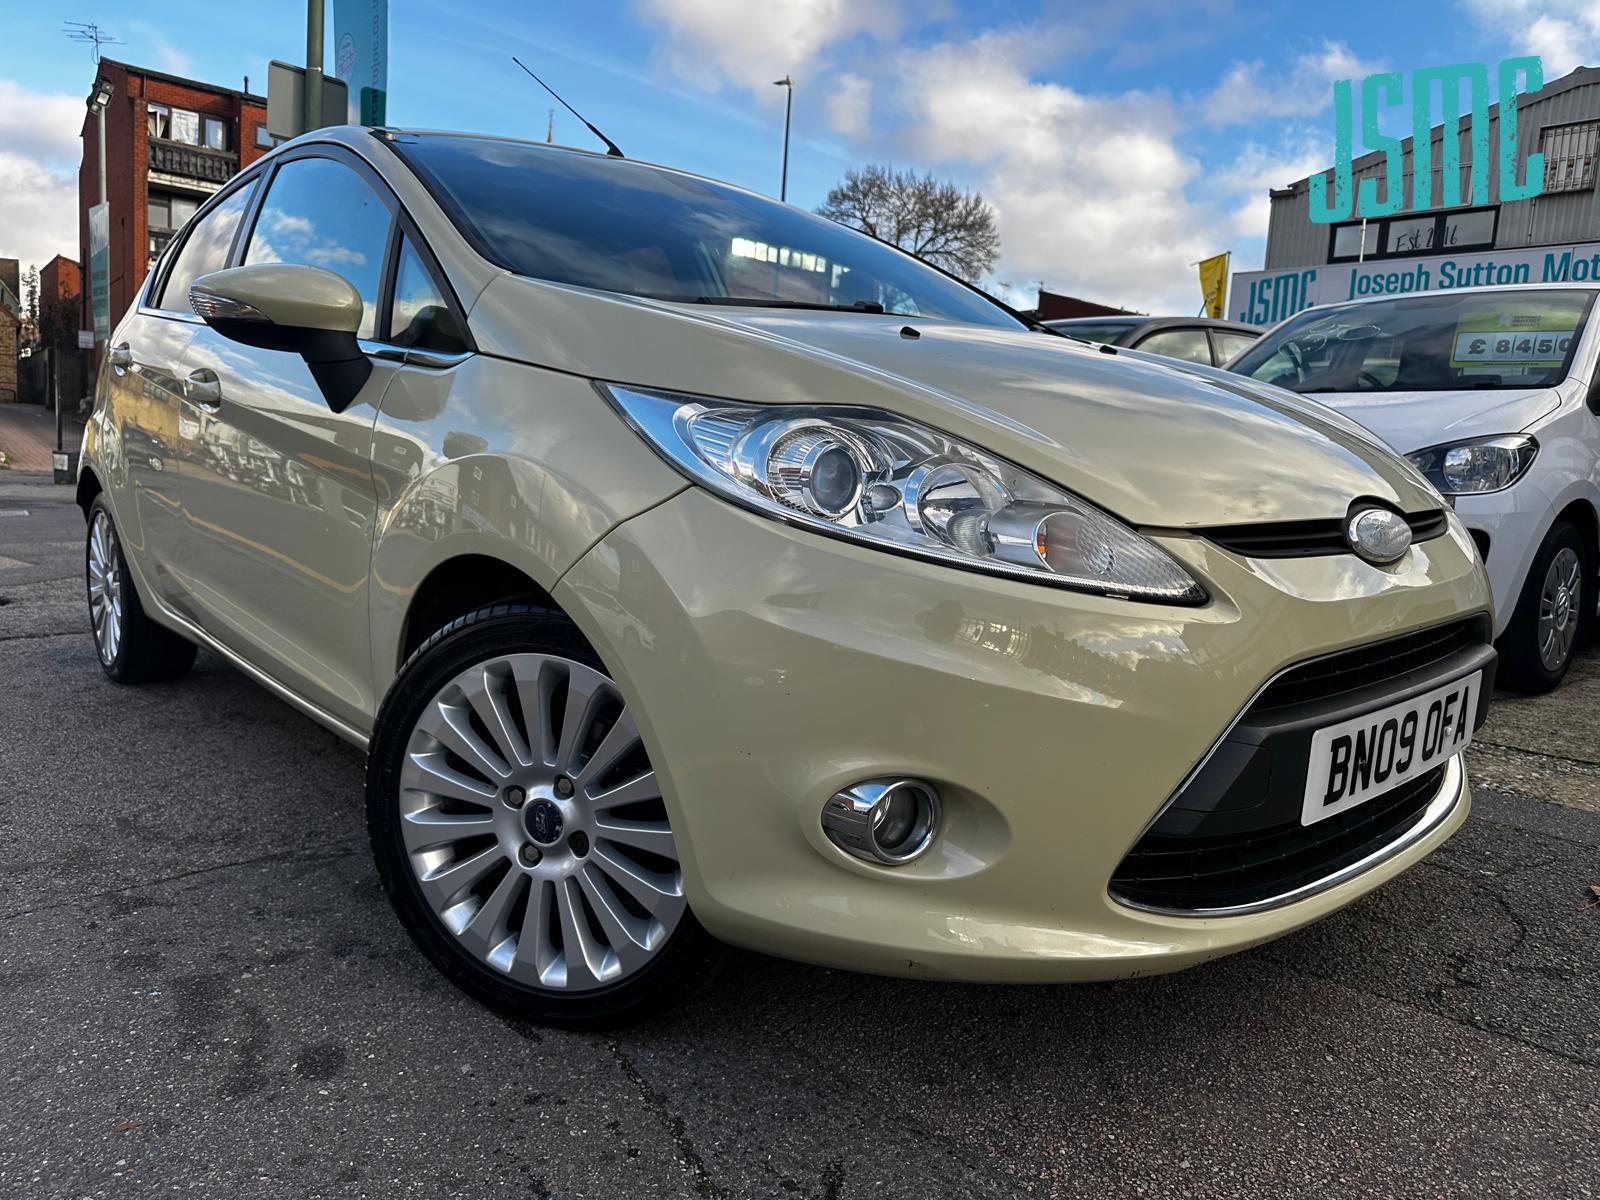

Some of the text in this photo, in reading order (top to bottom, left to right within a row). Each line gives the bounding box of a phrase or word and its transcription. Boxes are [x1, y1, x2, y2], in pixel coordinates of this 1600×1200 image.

[1240, 269, 1316, 325] JSMC
[1346, 263, 1430, 301] Joseph
[1438, 261, 1530, 289] Sutton
[1495, 338, 1571, 354] 8450
[1323, 686, 1469, 807] BN09 OFA
